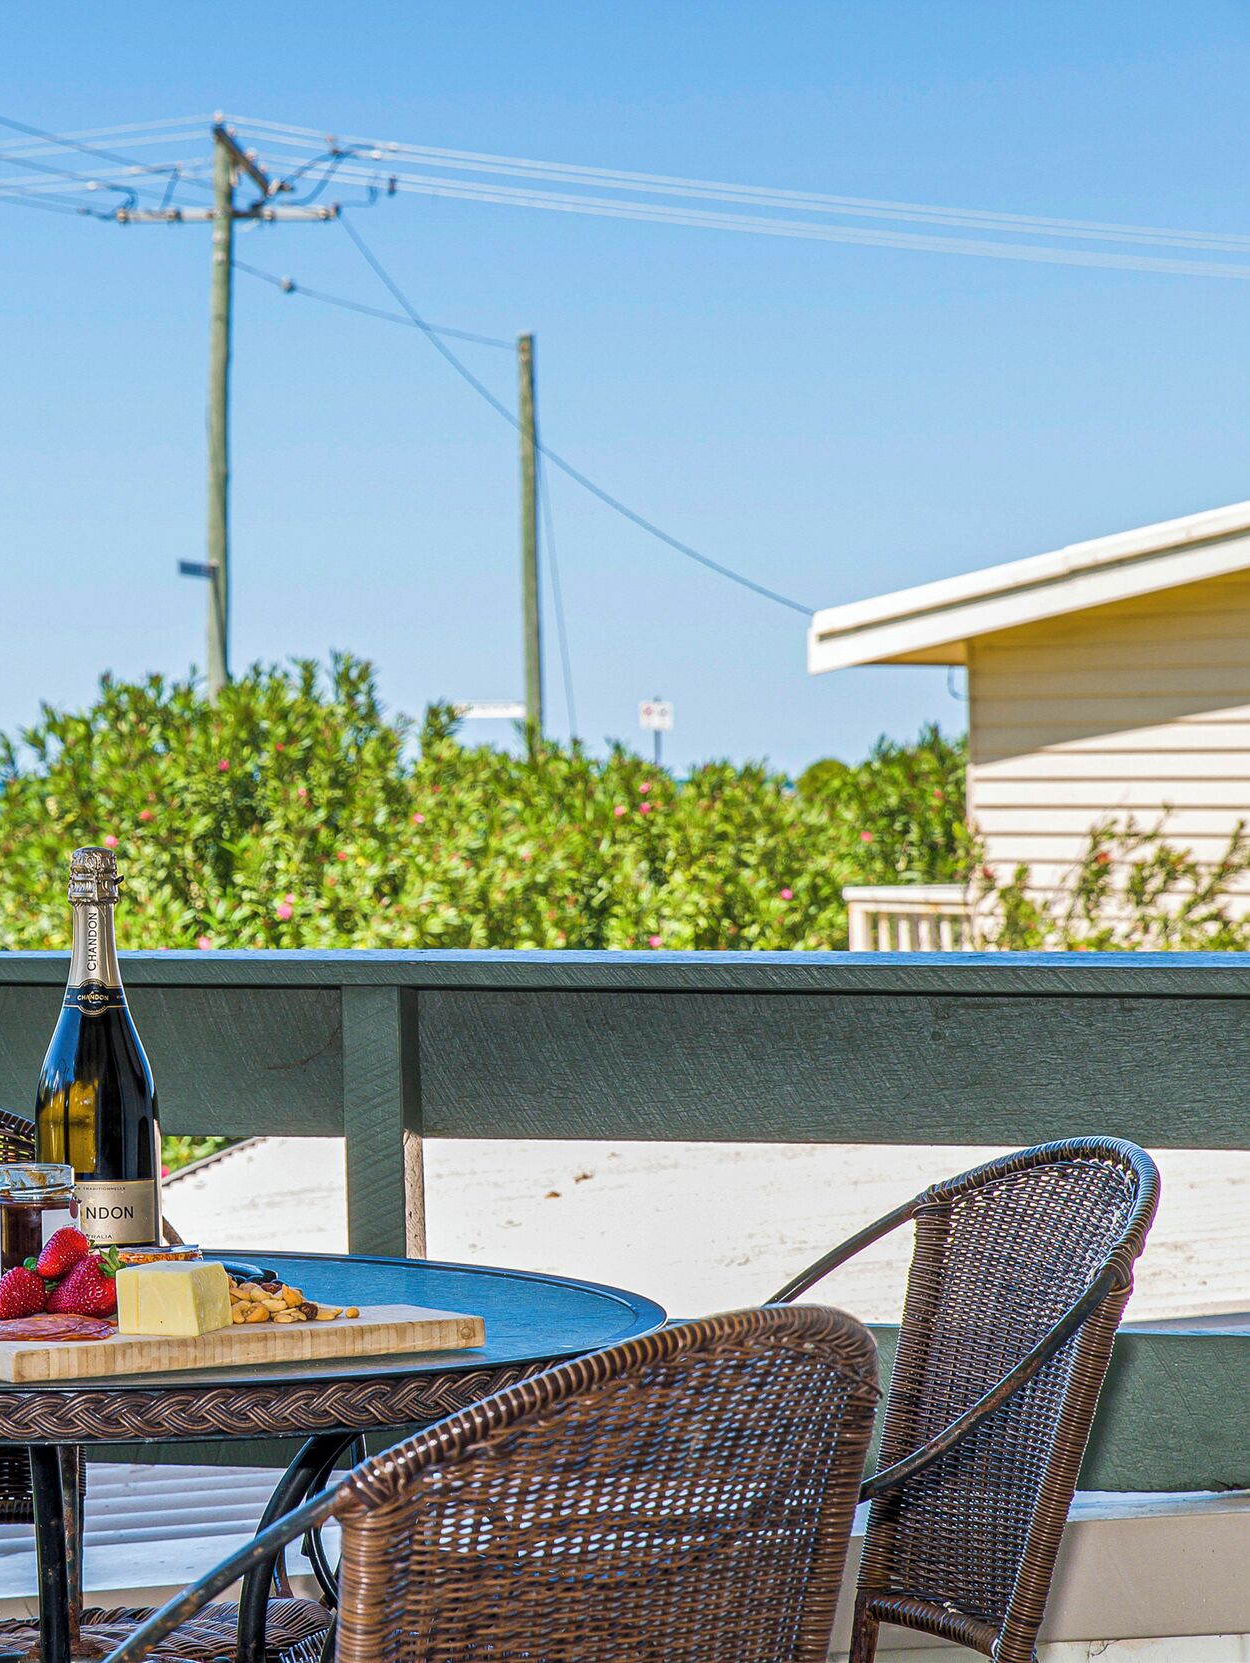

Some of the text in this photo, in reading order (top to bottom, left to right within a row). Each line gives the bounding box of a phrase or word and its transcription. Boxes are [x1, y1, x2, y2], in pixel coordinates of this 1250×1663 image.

[86, 912, 98, 971] CHANDON
[77, 993, 109, 1001] CHANDON
[86, 1206, 134, 1219] NDON
